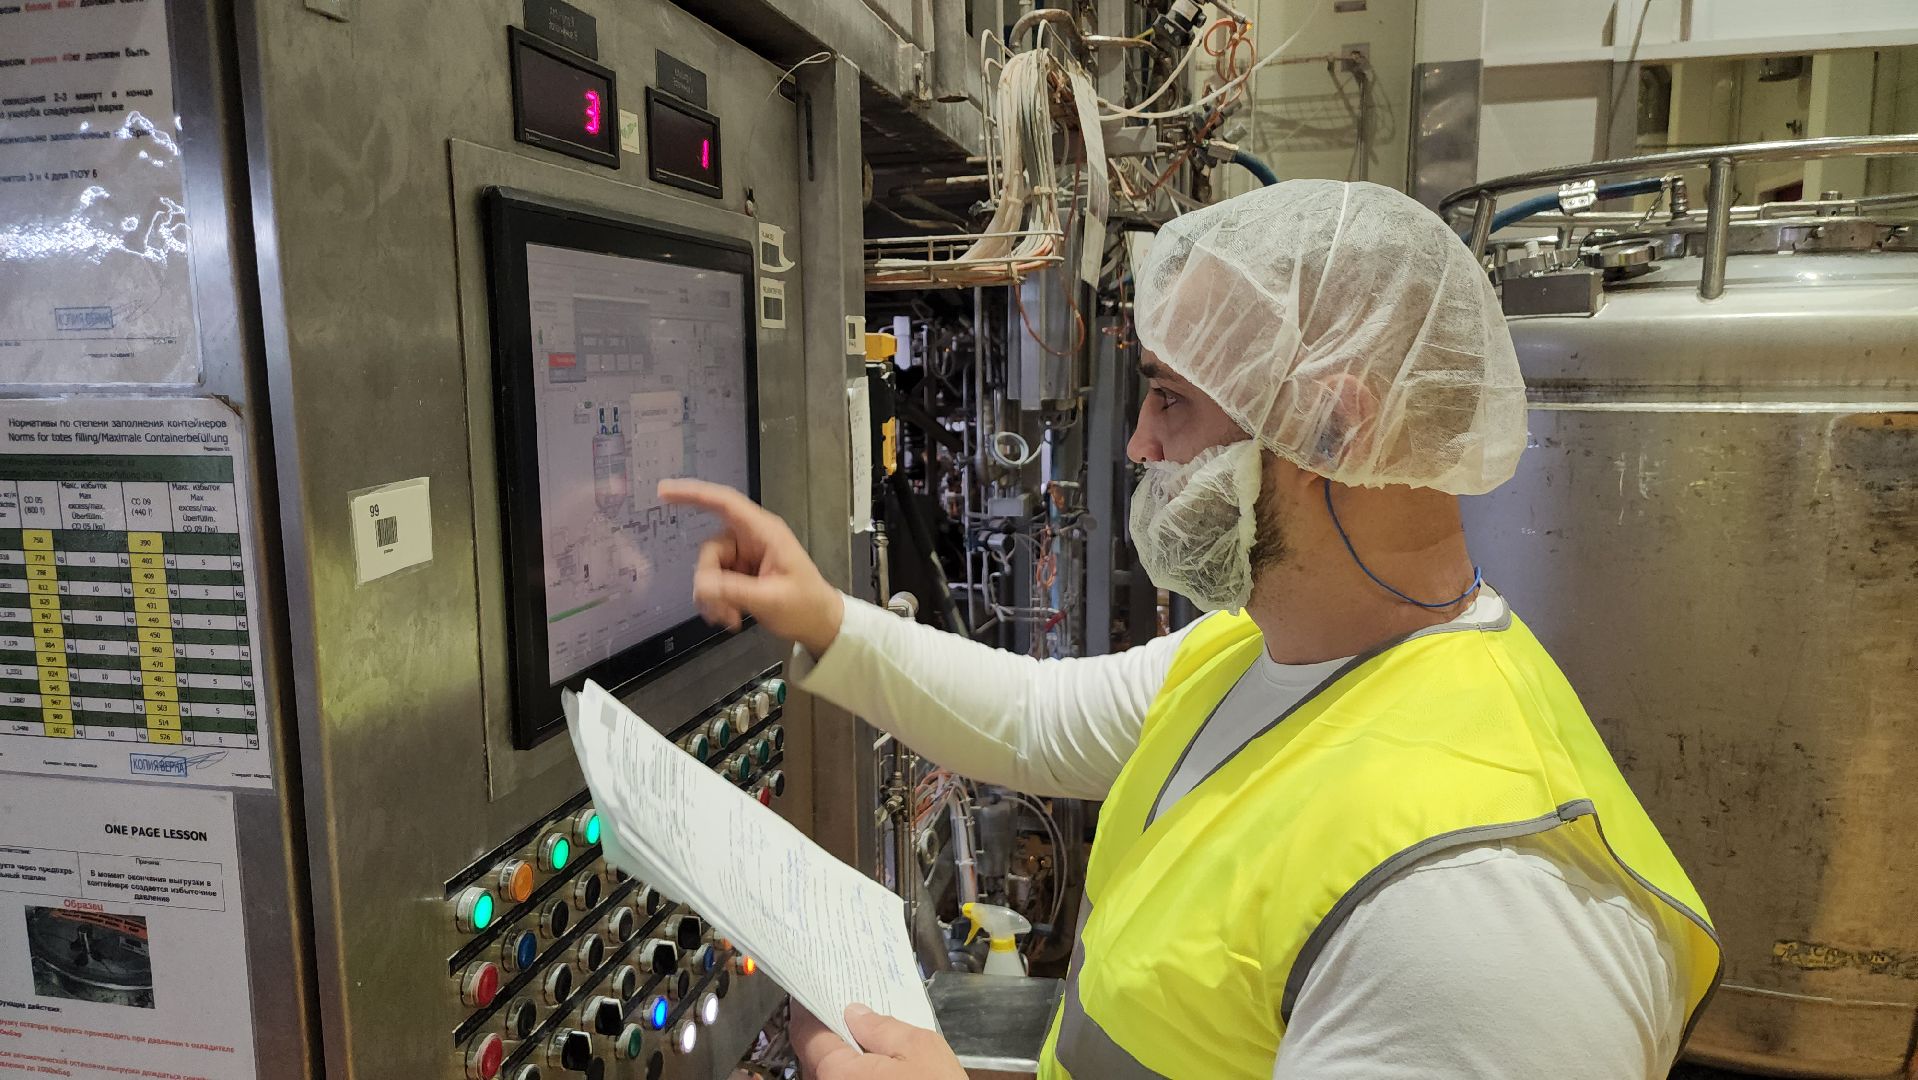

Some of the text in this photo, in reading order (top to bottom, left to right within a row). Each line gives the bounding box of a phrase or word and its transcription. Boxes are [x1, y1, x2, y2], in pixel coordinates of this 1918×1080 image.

[582, 90, 601, 135] 3
[702, 139, 710, 170] 1
[8, 417, 228, 431] Нормативы по степени заполнения контейнеров
[8, 432, 229, 446] Norms for totes filling/Maximale Containerbefüllung
[369, 503, 380, 518] 99
[166, 557, 175, 566] kg
[232, 559, 241, 568] kg
[144, 587, 156, 595] 422
[170, 588, 178, 597] kg
[235, 590, 244, 599] kg
[146, 602, 158, 610] 431
[172, 618, 181, 626] kg
[238, 620, 246, 629] kg
[149, 631, 161, 639] 450
[175, 647, 184, 656] kg
[241, 649, 249, 658] kg
[152, 660, 164, 668] 470
[178, 676, 187, 685] kg
[243, 679, 252, 688] kg
[104, 701, 112, 709] 10
[181, 705, 189, 714] kg
[246, 708, 255, 717] kg
[184, 734, 192, 742] kg
[249, 738, 258, 747] kg
[132, 758, 186, 774] КОПИЯ ВЕРНА
[104, 823, 208, 842] ONE PAGE LESSON
[90, 869, 96, 877] В
[97, 871, 125, 879] момент
[127, 874, 167, 883] окончания
[168, 878, 205, 888] выгрузки
[86, 879, 217, 898] контейнере создается избыточное
[133, 893, 170, 904] давление
[63, 898, 105, 913] Образец
[84, 1030, 131, 1042] производить
[131, 1035, 146, 1044] при
[147, 1037, 184, 1049] давлении
[190, 1043, 235, 1055] охладителе
[13, 1053, 68, 1065] автоматической
[69, 1059, 106, 1071] остановки
[141, 1069, 182, 1080] дождаться
